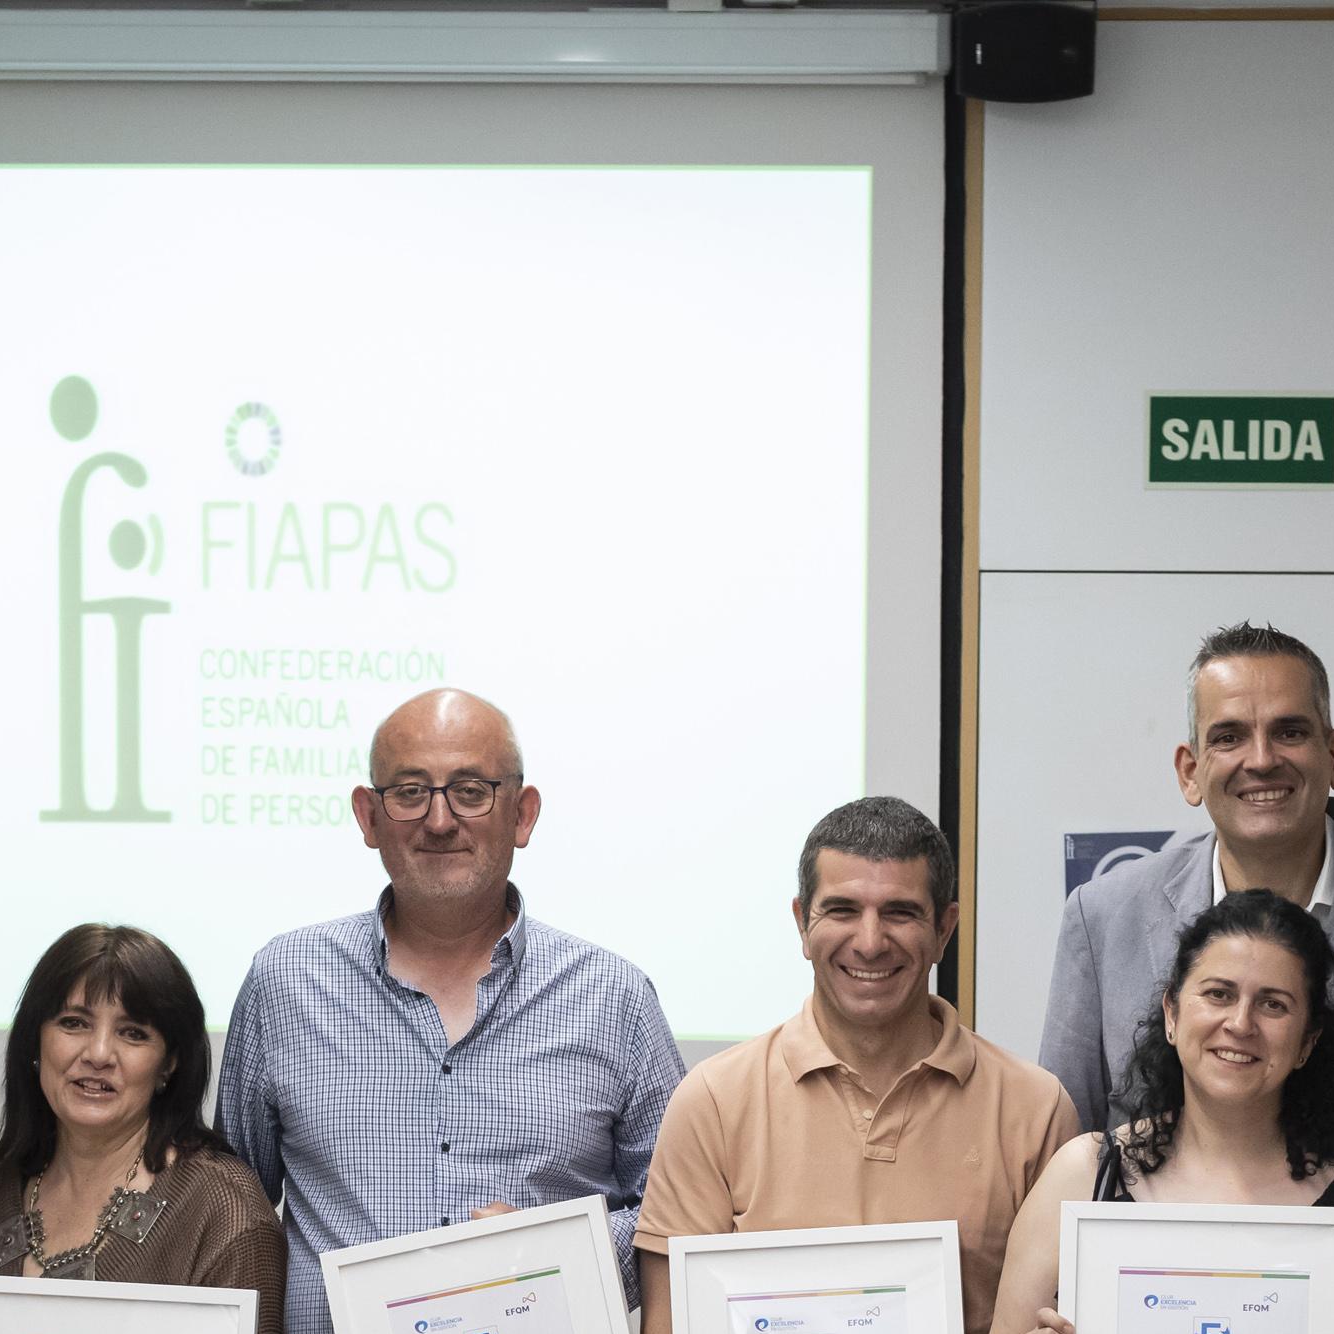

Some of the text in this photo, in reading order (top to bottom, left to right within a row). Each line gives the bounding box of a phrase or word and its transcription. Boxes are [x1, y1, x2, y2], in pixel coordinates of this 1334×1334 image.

[1161, 418, 1325, 461] SALIDA
[200, 500, 458, 593] FIAPAS
[198, 646, 446, 682] CONFEDERACIÓN
[200, 692, 351, 729] ESPAÑOLA
[200, 745, 372, 778] DE FAMILIA
[200, 793, 237, 825] DE
[505, 1305, 530, 1316] EFQM
[848, 1319, 873, 1327] EFQM
[1243, 1304, 1269, 1312] EFQM
